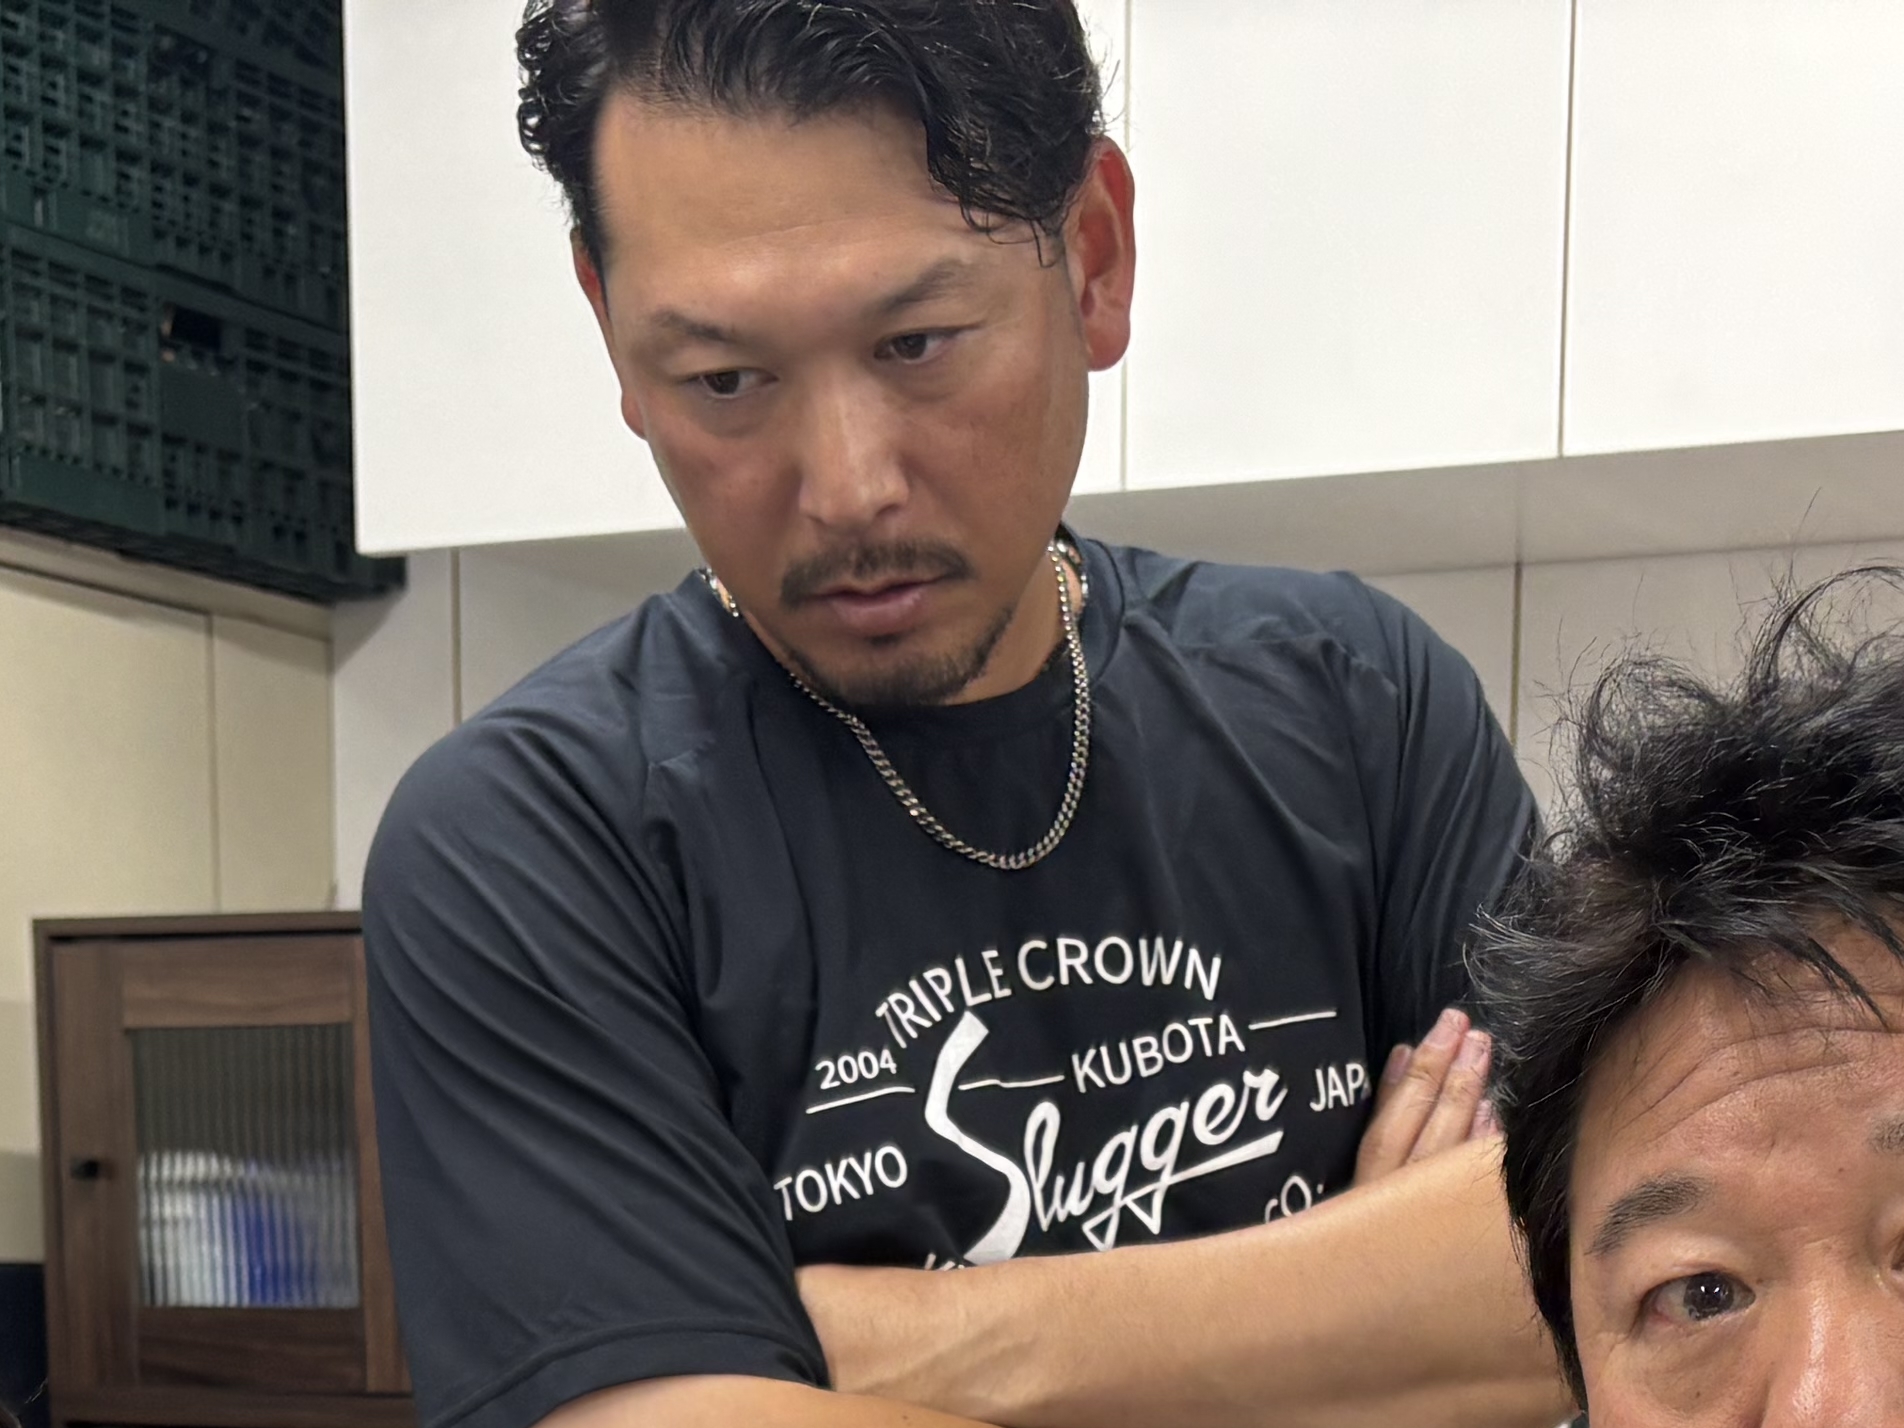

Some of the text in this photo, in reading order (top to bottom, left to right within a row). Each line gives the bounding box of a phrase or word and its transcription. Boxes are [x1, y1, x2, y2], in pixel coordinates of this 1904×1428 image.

[875, 935, 1224, 1049] TRIPLE CROWN
[814, 1048, 899, 1090] 2004
[1071, 1013, 1247, 1094] KUBOTA
[924, 1010, 1290, 1266] Slugger
[773, 1144, 909, 1222] TOKYO
